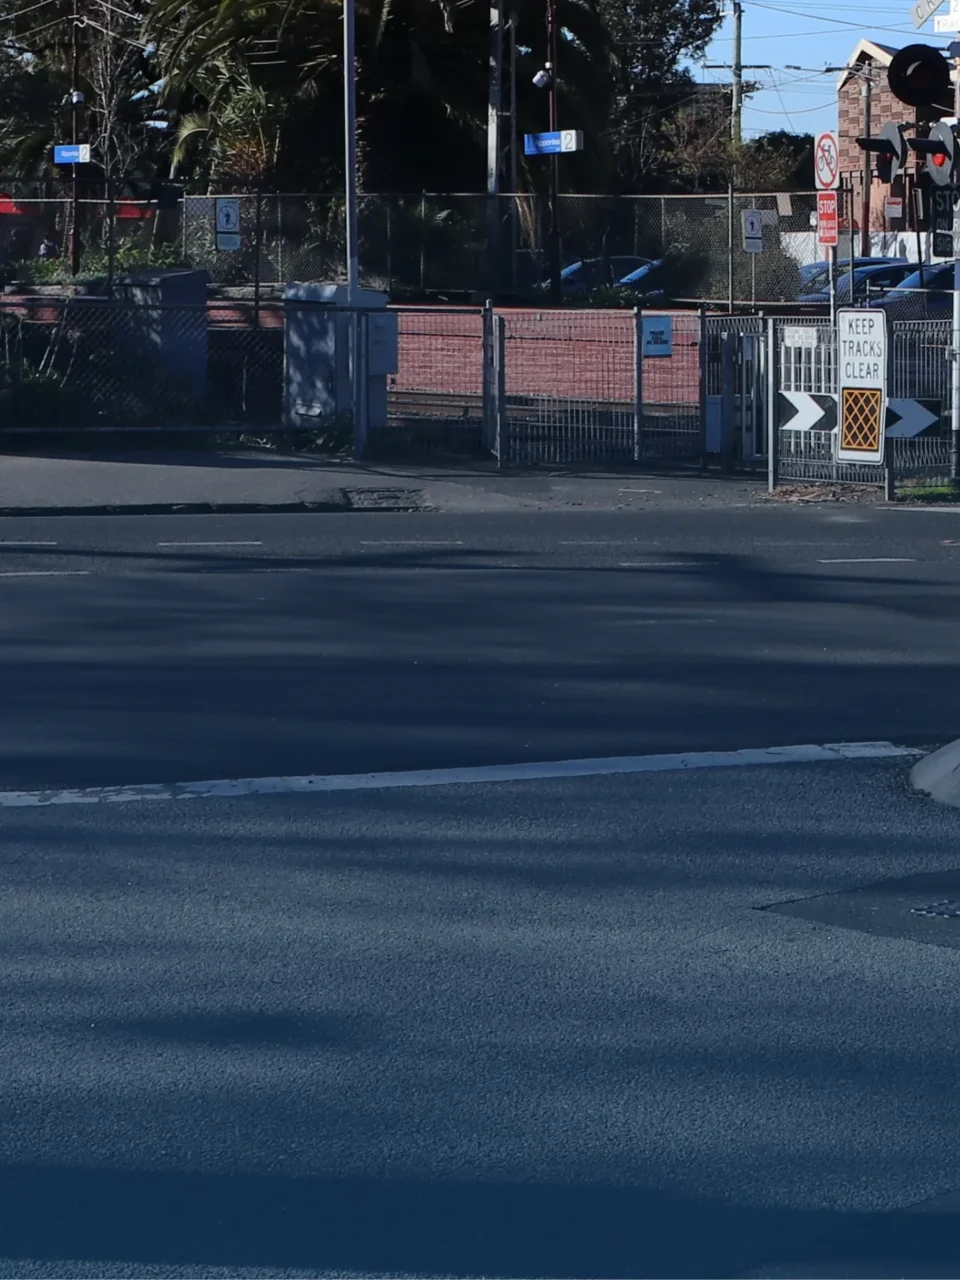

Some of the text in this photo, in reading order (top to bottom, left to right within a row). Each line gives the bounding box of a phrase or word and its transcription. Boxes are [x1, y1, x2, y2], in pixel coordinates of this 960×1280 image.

[952, 0, 960, 13] 2
[564, 132, 573, 150] 2
[82, 146, 88, 161] 2
[819, 200, 836, 214] STOP
[936, 219, 949, 231] ON
[848, 318, 875, 335] KEEP
[842, 340, 882, 357] TRACKS
[845, 362, 879, 379] CLEAR
